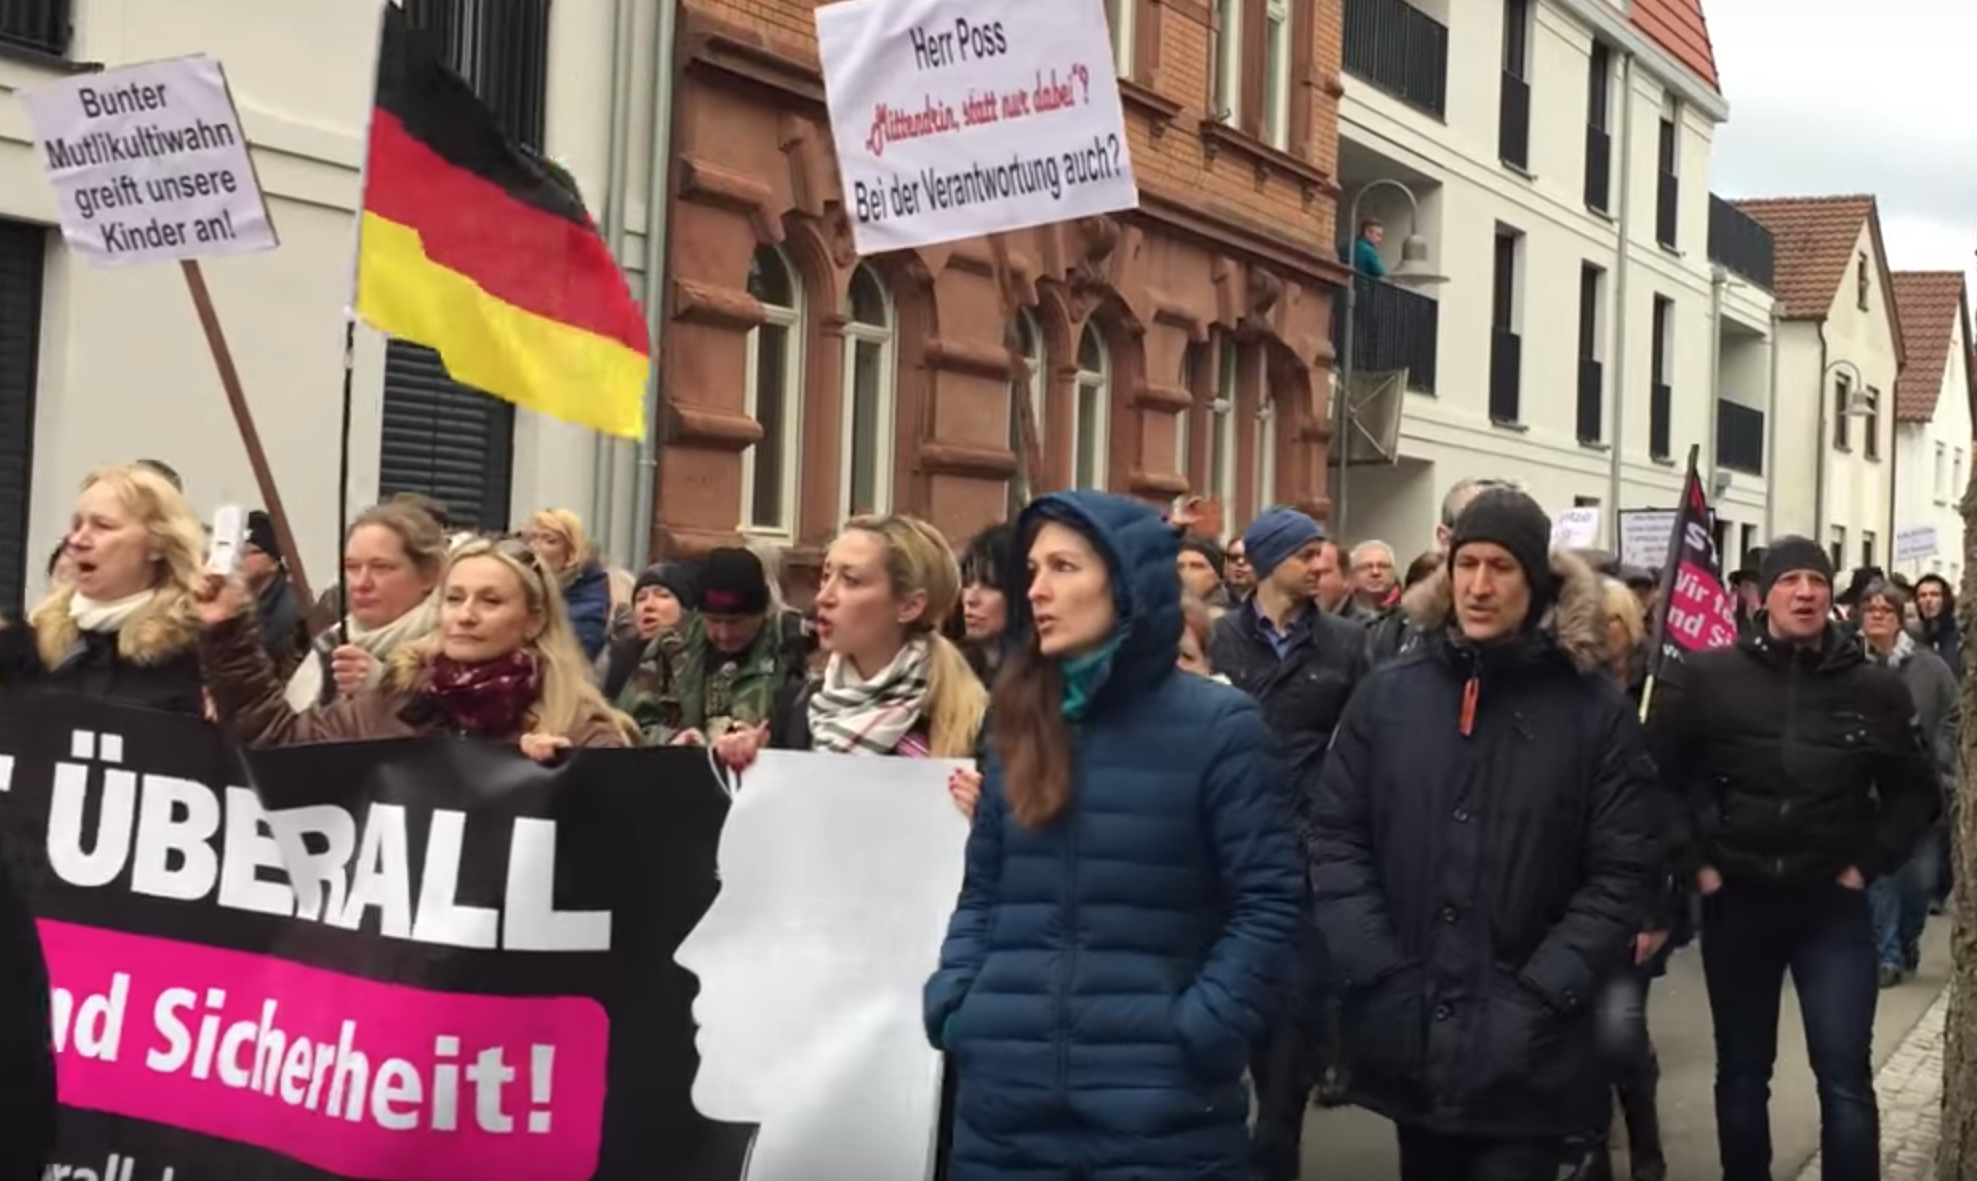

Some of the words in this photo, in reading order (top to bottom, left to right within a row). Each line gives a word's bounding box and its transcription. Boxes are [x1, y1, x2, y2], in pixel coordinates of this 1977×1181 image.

[909, 25, 953, 70] Herr
[955, 18, 1007, 61] Poss
[79, 82, 168, 119] Bunter
[963, 90, 998, 126] statt
[1002, 91, 1030, 119] nur
[45, 118, 235, 170] Mutlikultiwahn
[74, 175, 144, 219] greift
[146, 169, 238, 203] unsere
[854, 177, 888, 223] Bei
[890, 173, 920, 217] der
[920, 154, 1061, 210] Verantwortung
[1062, 133, 1121, 185] auch?
[100, 217, 187, 253] Kinder
[194, 208, 237, 243] an!
[46, 729, 612, 951] ÜBERALL
[145, 986, 556, 1133] Sicherheit!
